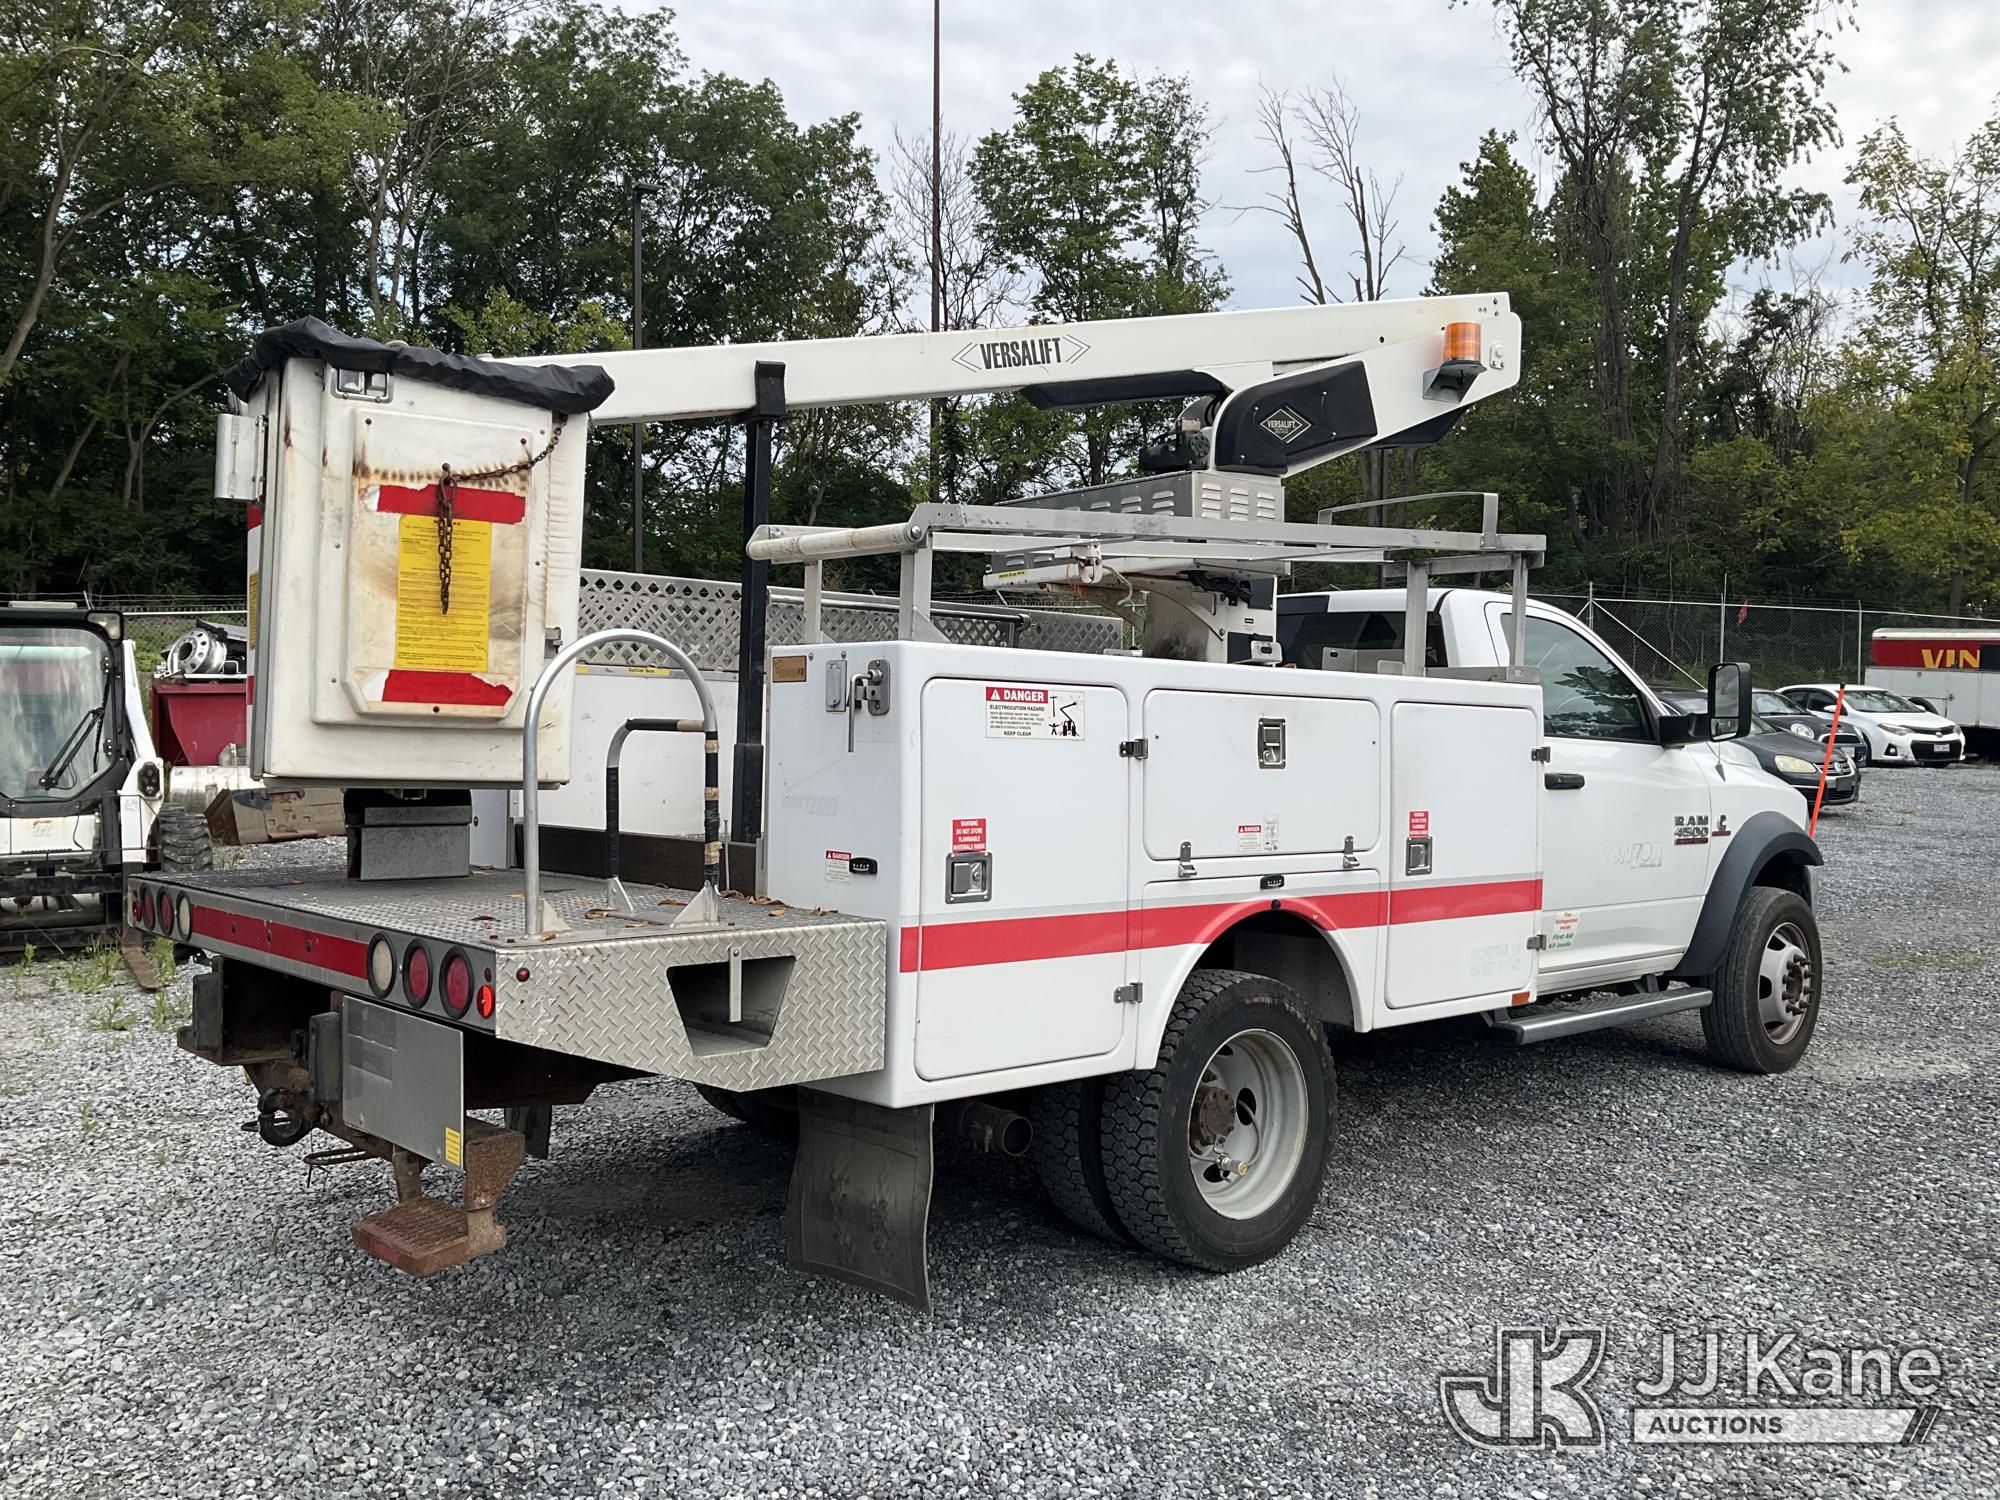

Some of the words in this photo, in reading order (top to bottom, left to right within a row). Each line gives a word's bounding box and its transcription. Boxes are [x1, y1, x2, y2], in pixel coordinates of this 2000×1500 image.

[980, 337, 1062, 370] VERSALIFT
[1267, 420, 1296, 429] VERSALIFT
[1921, 649, 1980, 669] VIN
[1003, 689, 1045, 702] DANGER
[1674, 815, 1708, 826] RAM
[1674, 826, 1709, 837] 4500
[832, 852, 850, 860] DANGER
